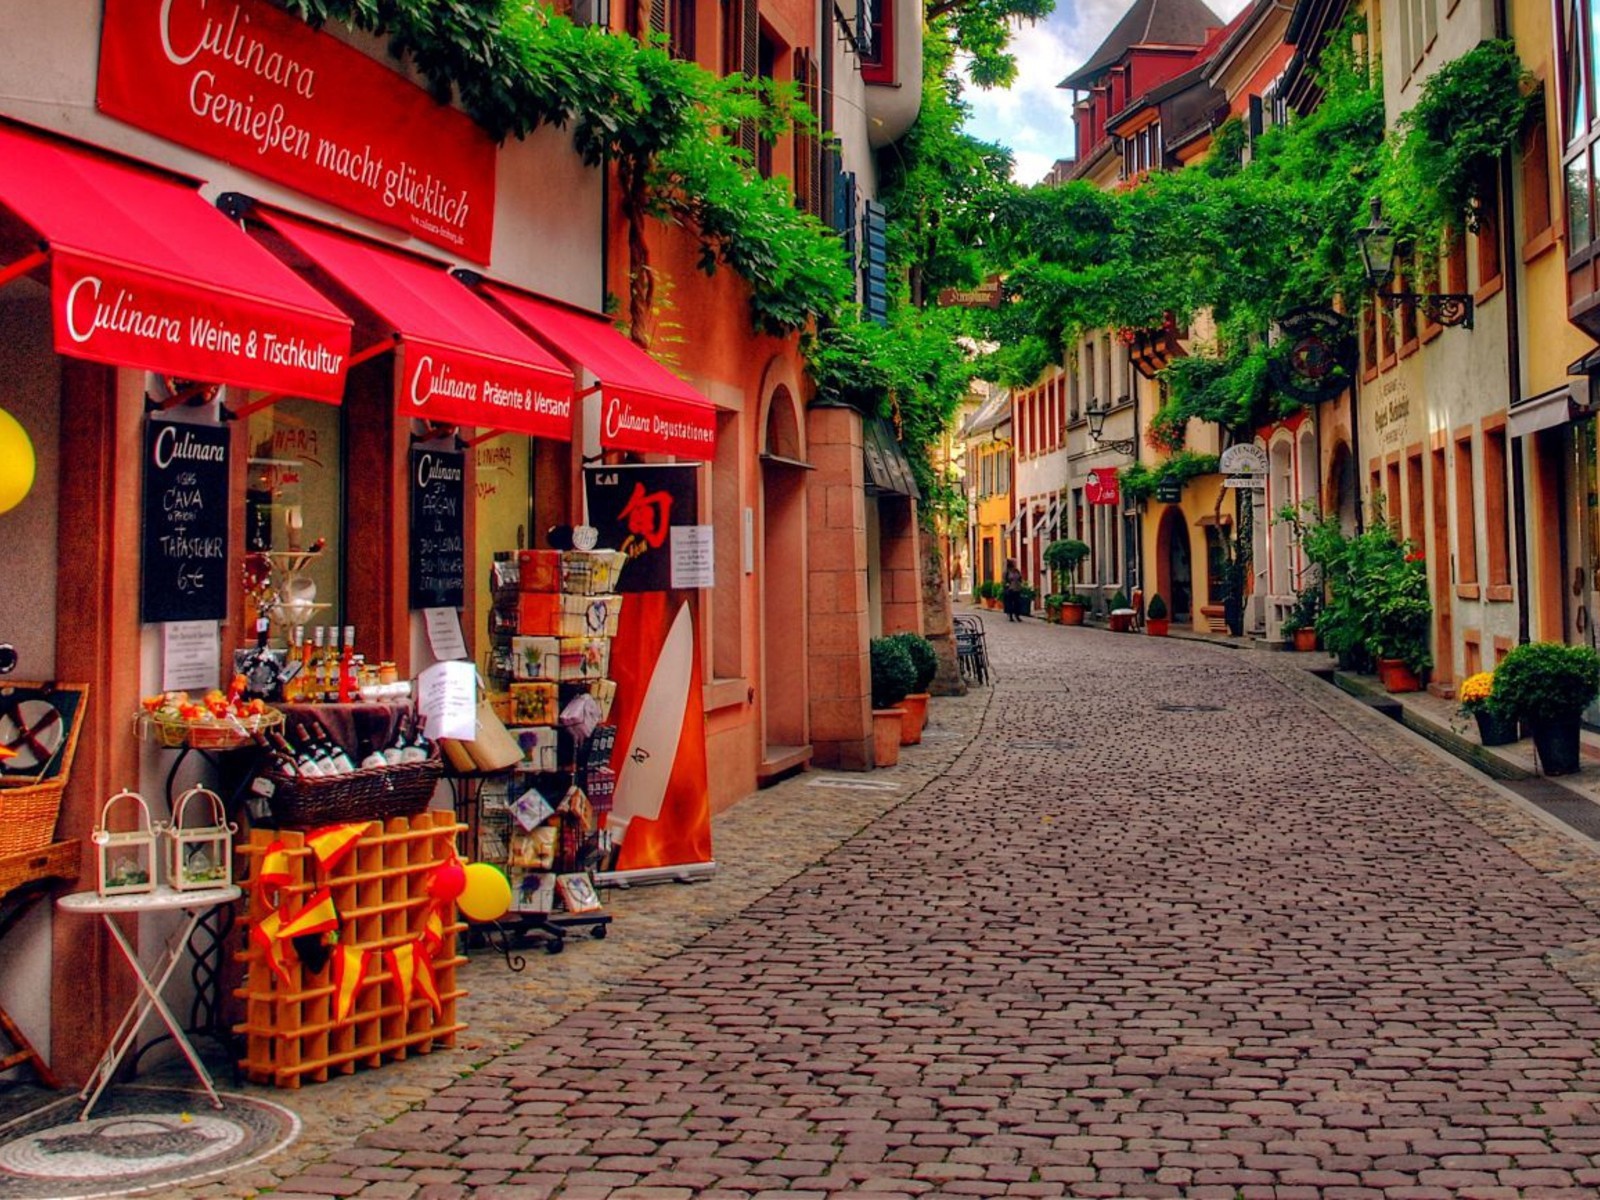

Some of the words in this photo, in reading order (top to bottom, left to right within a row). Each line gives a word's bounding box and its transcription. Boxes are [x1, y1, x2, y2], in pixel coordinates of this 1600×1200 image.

[160, 0, 315, 99] Culinara
[190, 70, 311, 159] Genießen
[315, 140, 383, 190] macht
[383, 161, 470, 228] glücklich
[66, 276, 181, 343] Culinara
[189, 315, 241, 356] Weine
[245, 329, 257, 359] &
[263, 332, 343, 375] Tischkultur
[410, 355, 477, 407] Culinara
[483, 380, 523, 409] Präsente
[524, 390, 531, 411] &
[534, 391, 571, 418] Versand
[154, 425, 225, 469] Culinara
[605, 398, 650, 438] Culinara
[653, 415, 714, 443] Degustationen
[163, 488, 203, 511] CAVA
[418, 454, 461, 488] Culinara
[617, 482, 674, 548] 旬
